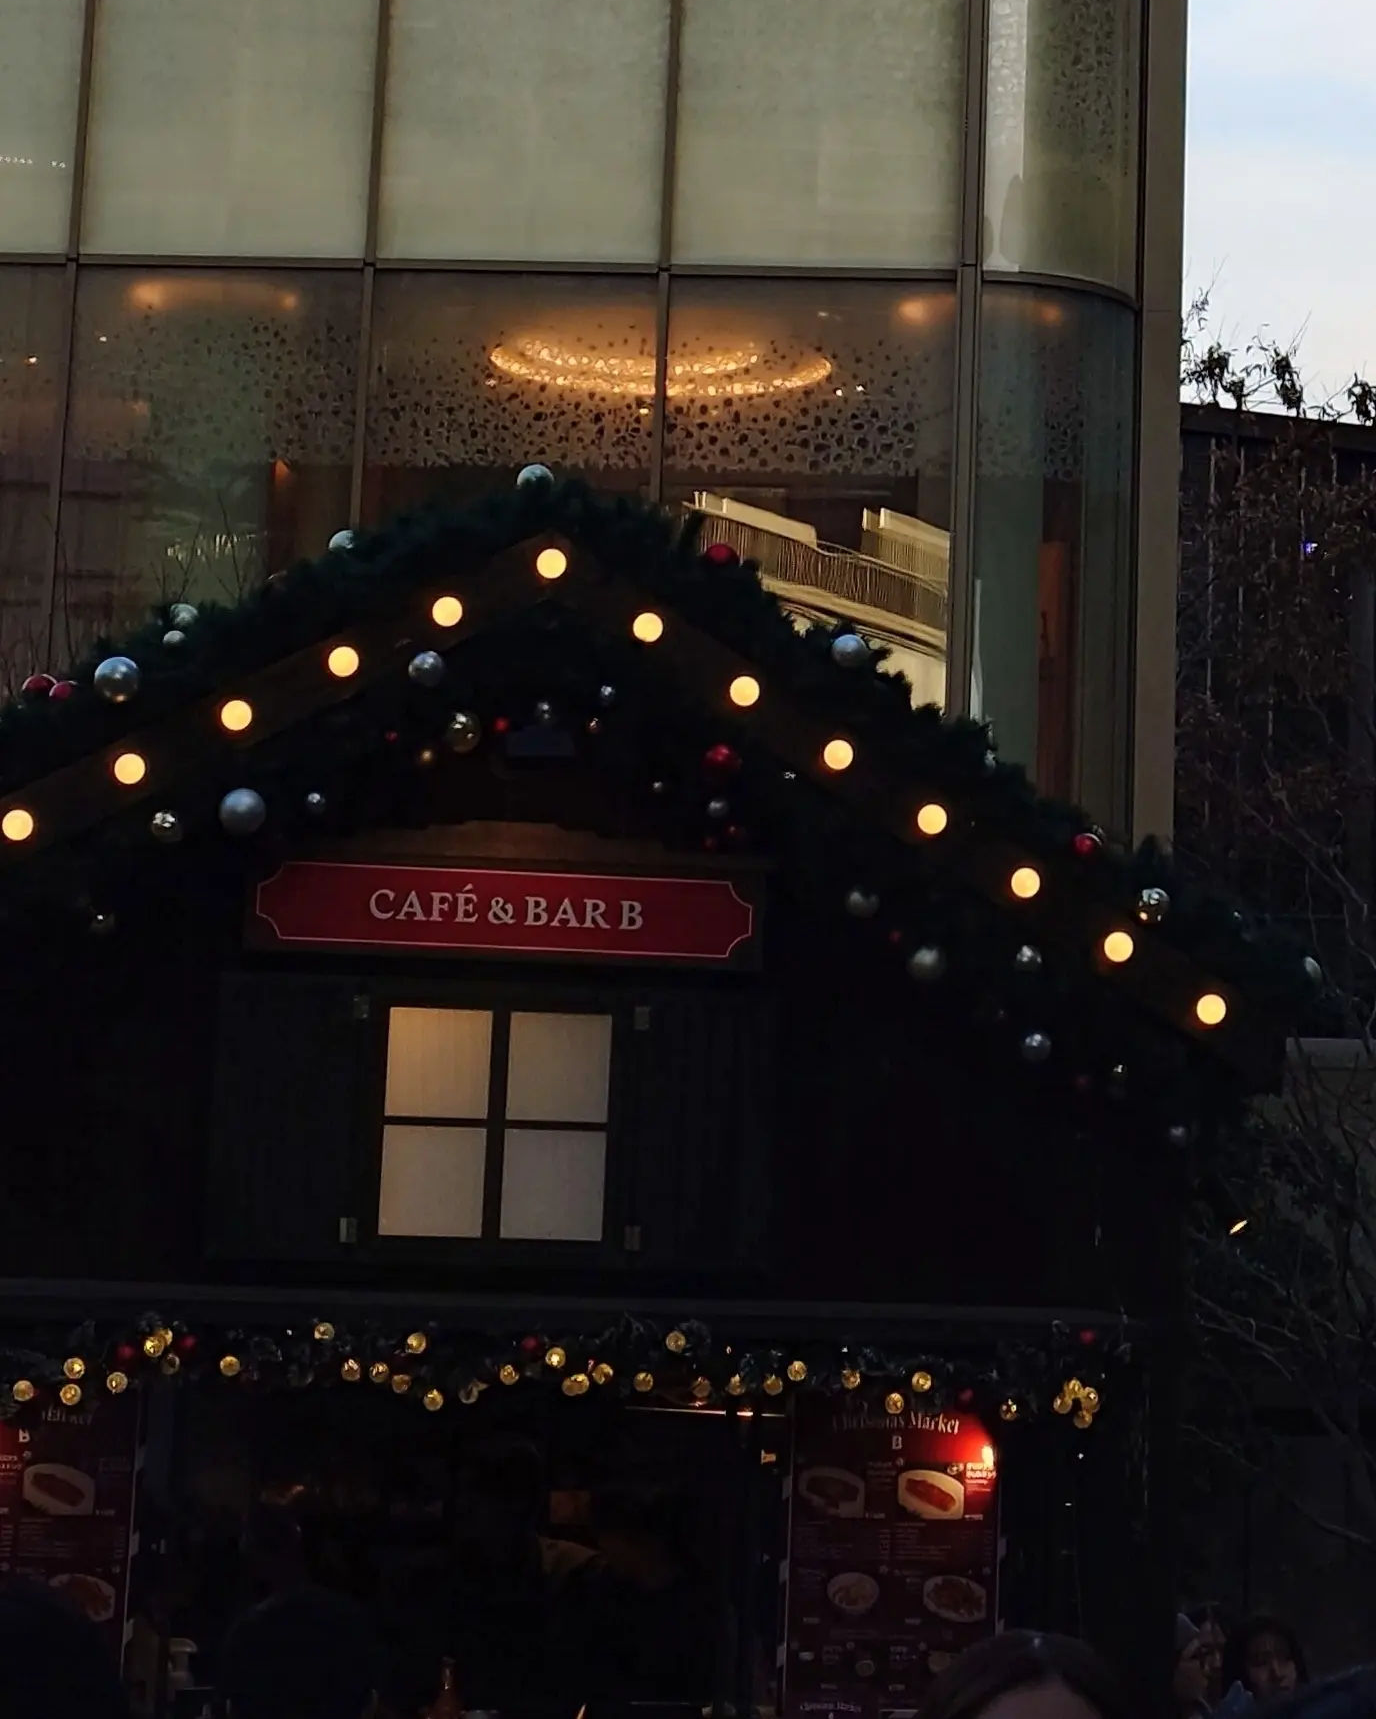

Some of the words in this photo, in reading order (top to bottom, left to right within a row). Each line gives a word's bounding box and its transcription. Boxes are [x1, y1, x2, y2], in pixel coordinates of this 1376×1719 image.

[369, 884, 479, 923] CAFÉ
[487, 897, 516, 924] &
[524, 896, 611, 929] BAR
[618, 900, 644, 930] B
